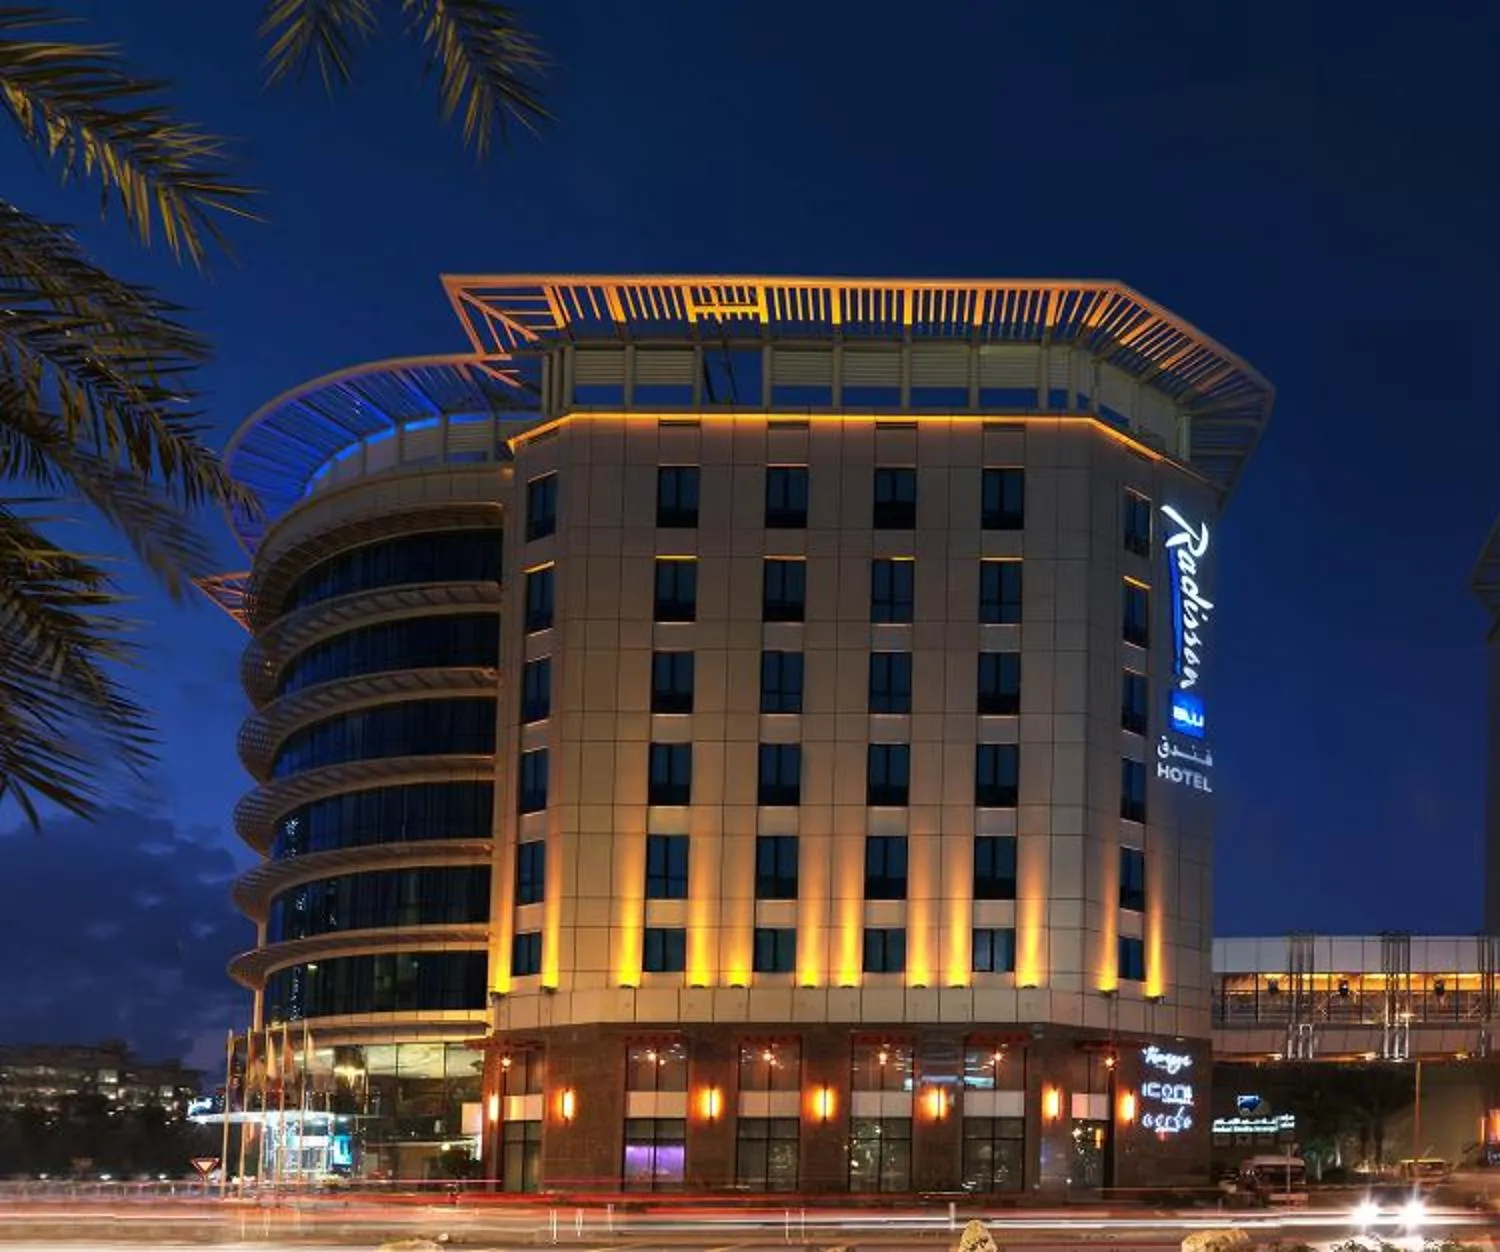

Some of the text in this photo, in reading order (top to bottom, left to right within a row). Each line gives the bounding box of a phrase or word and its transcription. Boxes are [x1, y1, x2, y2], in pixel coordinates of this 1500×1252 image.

[1160, 503, 1214, 690] Radisson
[1157, 735, 1214, 768] فندق
[1156, 762, 1214, 794] HOTEL
